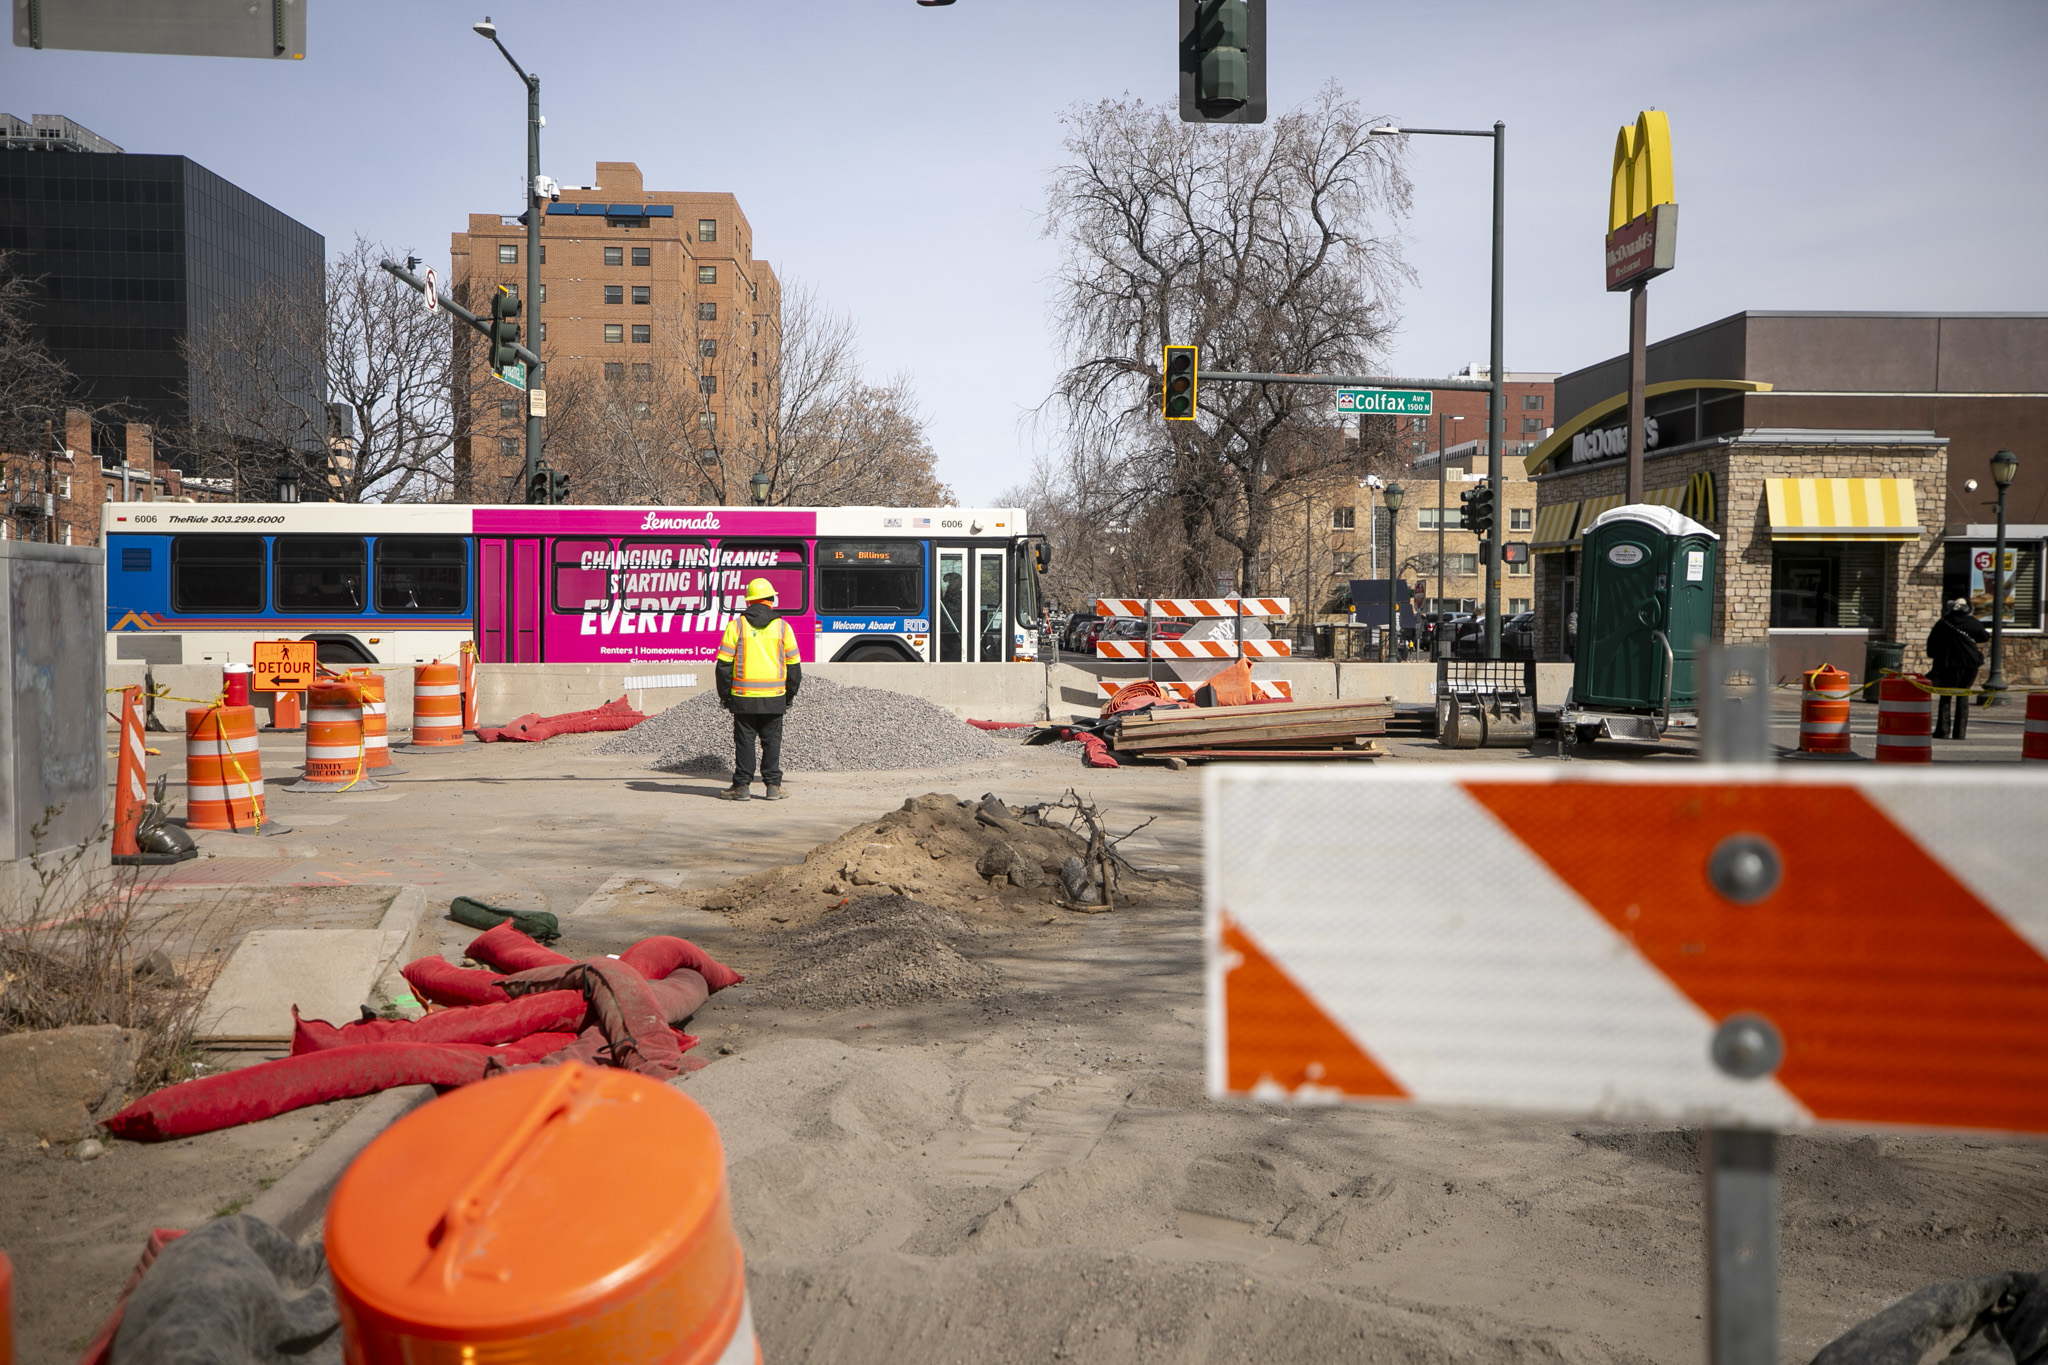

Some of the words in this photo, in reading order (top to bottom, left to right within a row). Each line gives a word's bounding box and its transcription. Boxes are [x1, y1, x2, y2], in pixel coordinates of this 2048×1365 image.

[1606, 231, 1653, 269] McDonald's
[1355, 393, 1405, 411] Colfax
[1407, 403, 1423, 411] 1500
[134, 515, 157, 523] 6006
[168, 515, 209, 523] TheRide
[210, 515, 286, 524] 303.299.6000
[640, 512, 721, 530] Lemonade
[941, 520, 963, 528] 6006
[580, 549, 673, 571] CHANGING
[678, 548, 780, 569] INSURANCE
[834, 551, 845, 559] 15
[857, 551, 890, 559] Billings
[610, 571, 691, 594] STARTING
[832, 620, 866, 630] Welcome
[868, 620, 897, 630] Aboard
[903, 618, 930, 632] RTD
[600, 646, 633, 655] Renters
[640, 646, 694, 655] Homeowners
[700, 646, 716, 655] Car
[258, 661, 311, 674] DETOUR
